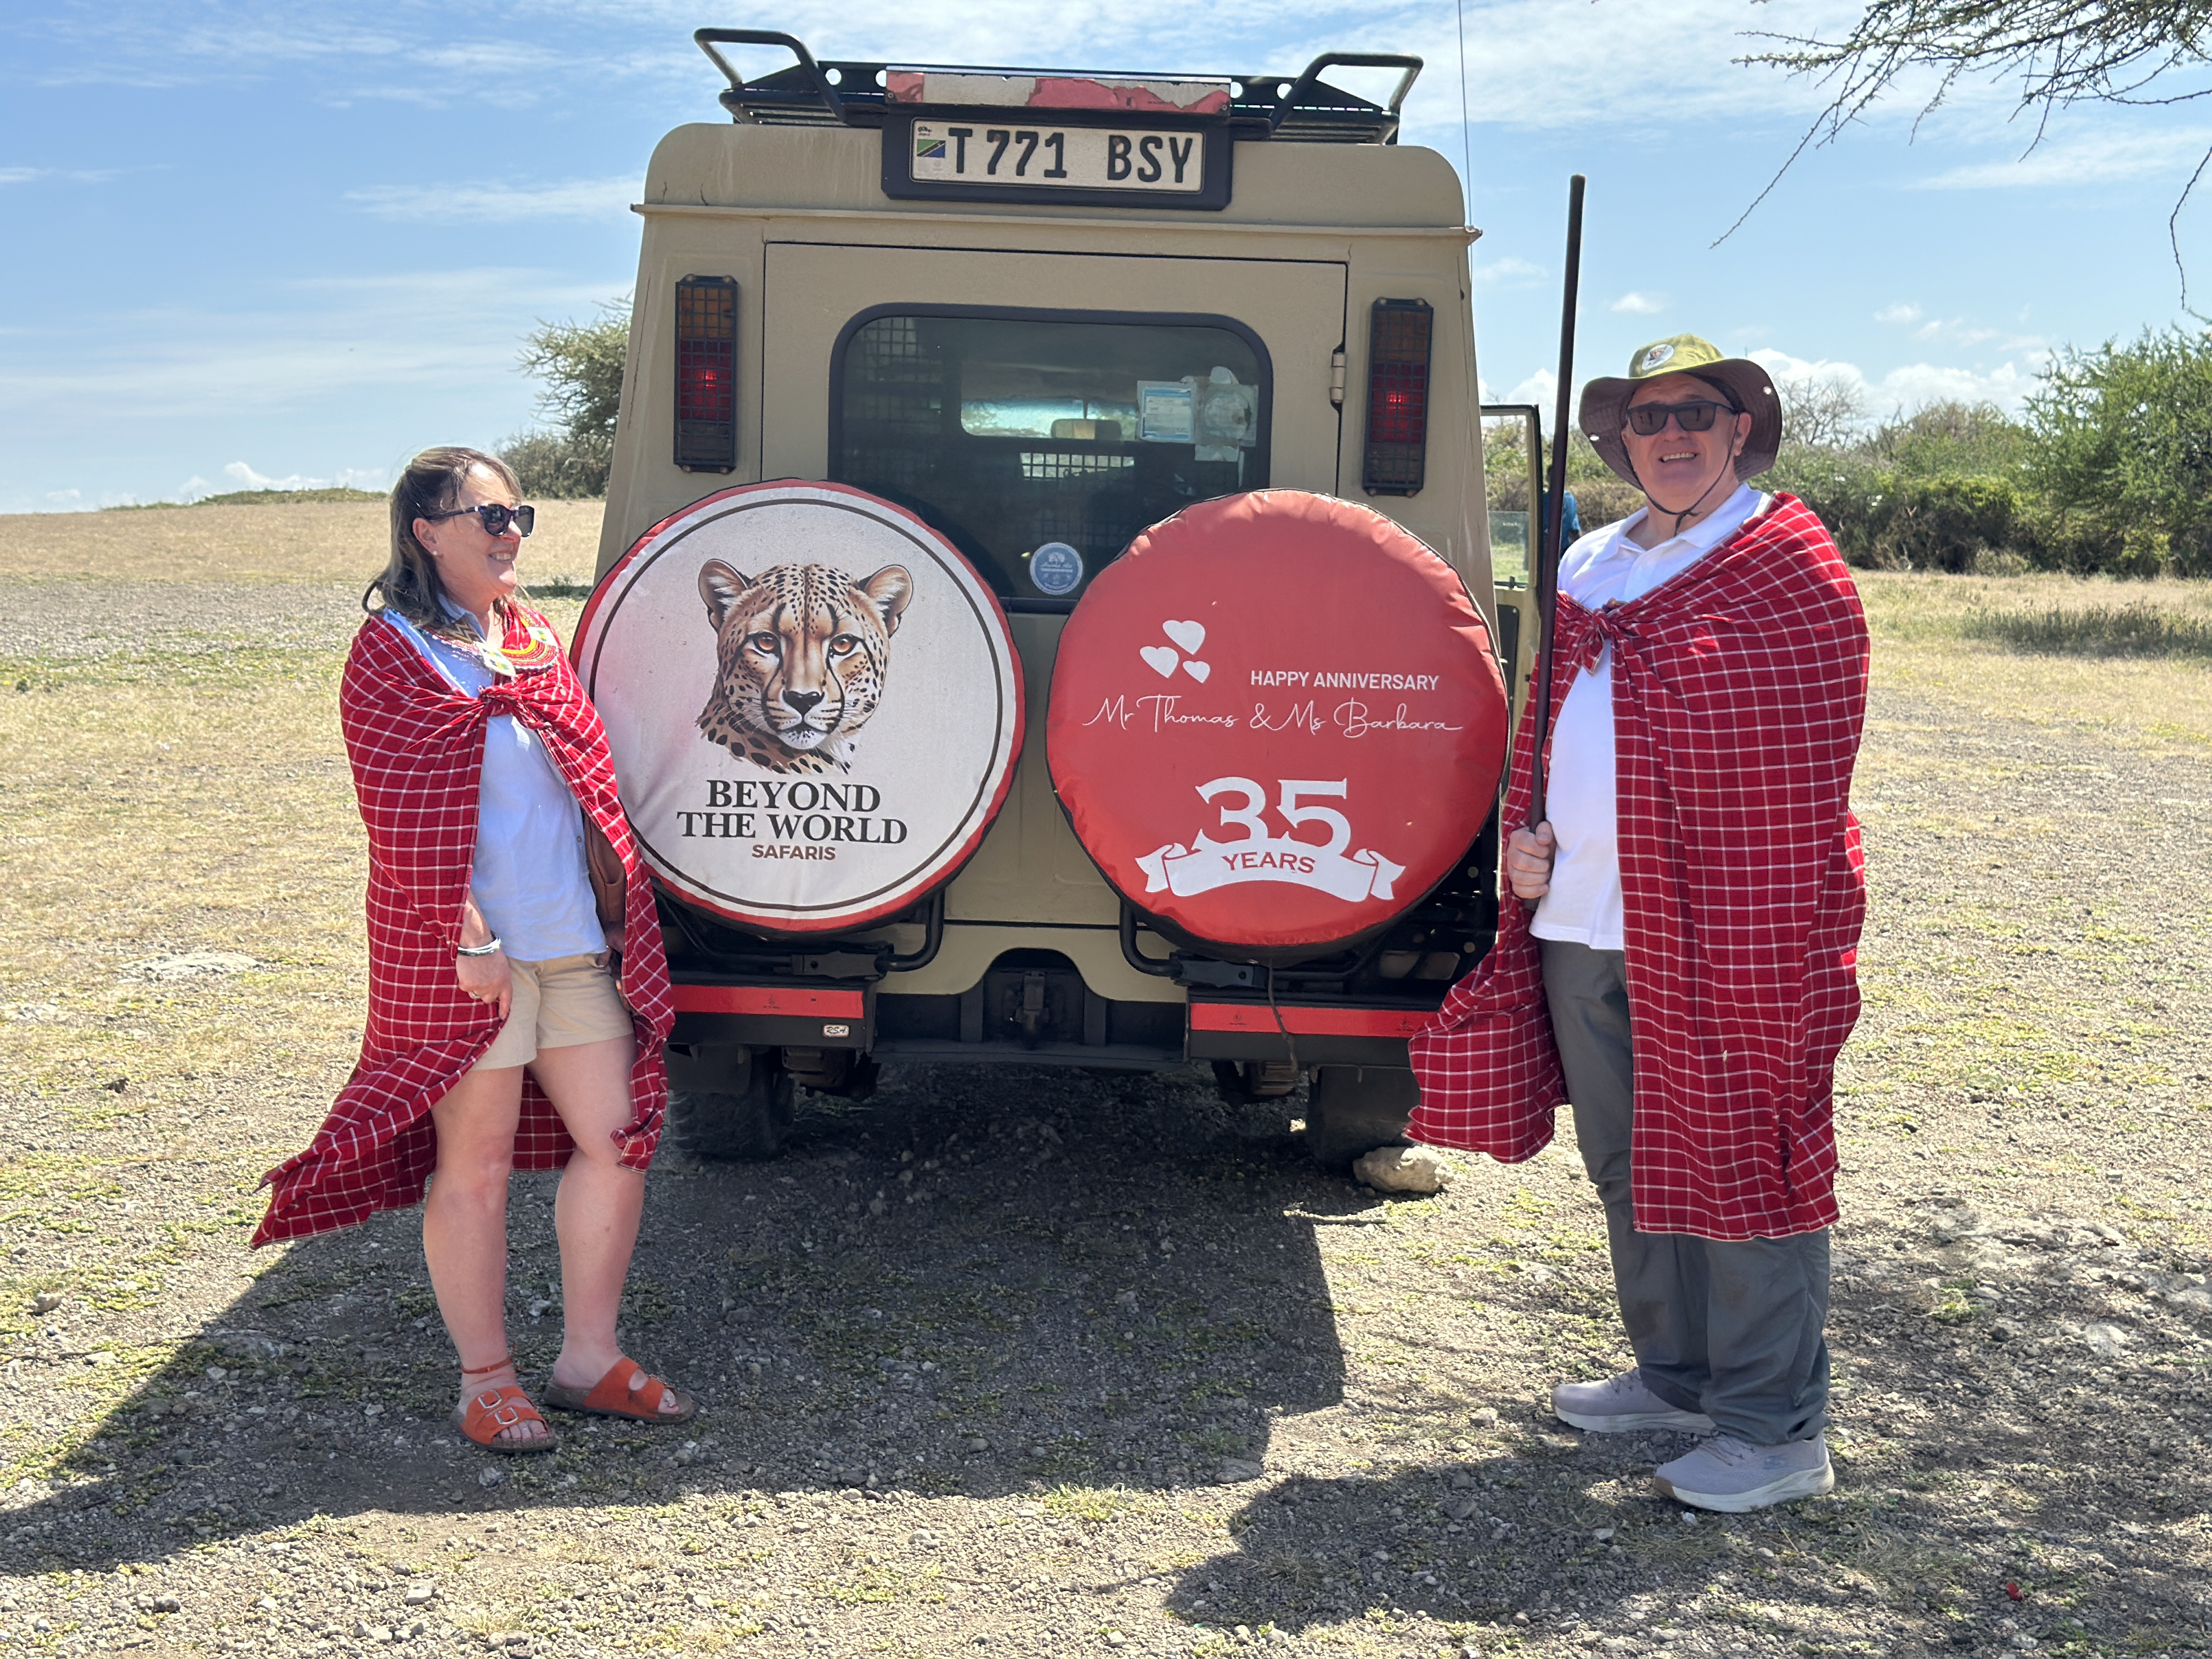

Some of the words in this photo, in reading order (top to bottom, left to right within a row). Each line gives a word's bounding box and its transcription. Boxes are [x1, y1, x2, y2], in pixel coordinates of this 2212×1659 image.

[949, 128, 973, 173] T
[987, 129, 1067, 178] 771
[1108, 135, 1193, 183] BSY
[1251, 670, 1310, 687] HAPPY
[1313, 672, 1440, 691] ANNIVERSARY
[1082, 694, 1134, 730] Mr
[1136, 693, 1240, 733] Thomas
[1250, 703, 1273, 730] &
[1271, 700, 1328, 735] Ms
[1334, 697, 1464, 738] Barbara
[706, 780, 881, 812] BEYOND
[676, 811, 757, 839] THE
[766, 814, 908, 844] WORLD
[1191, 776, 1351, 855] 35
[752, 844, 836, 861] SAFARIS
[1221, 851, 1316, 874] YEARS
